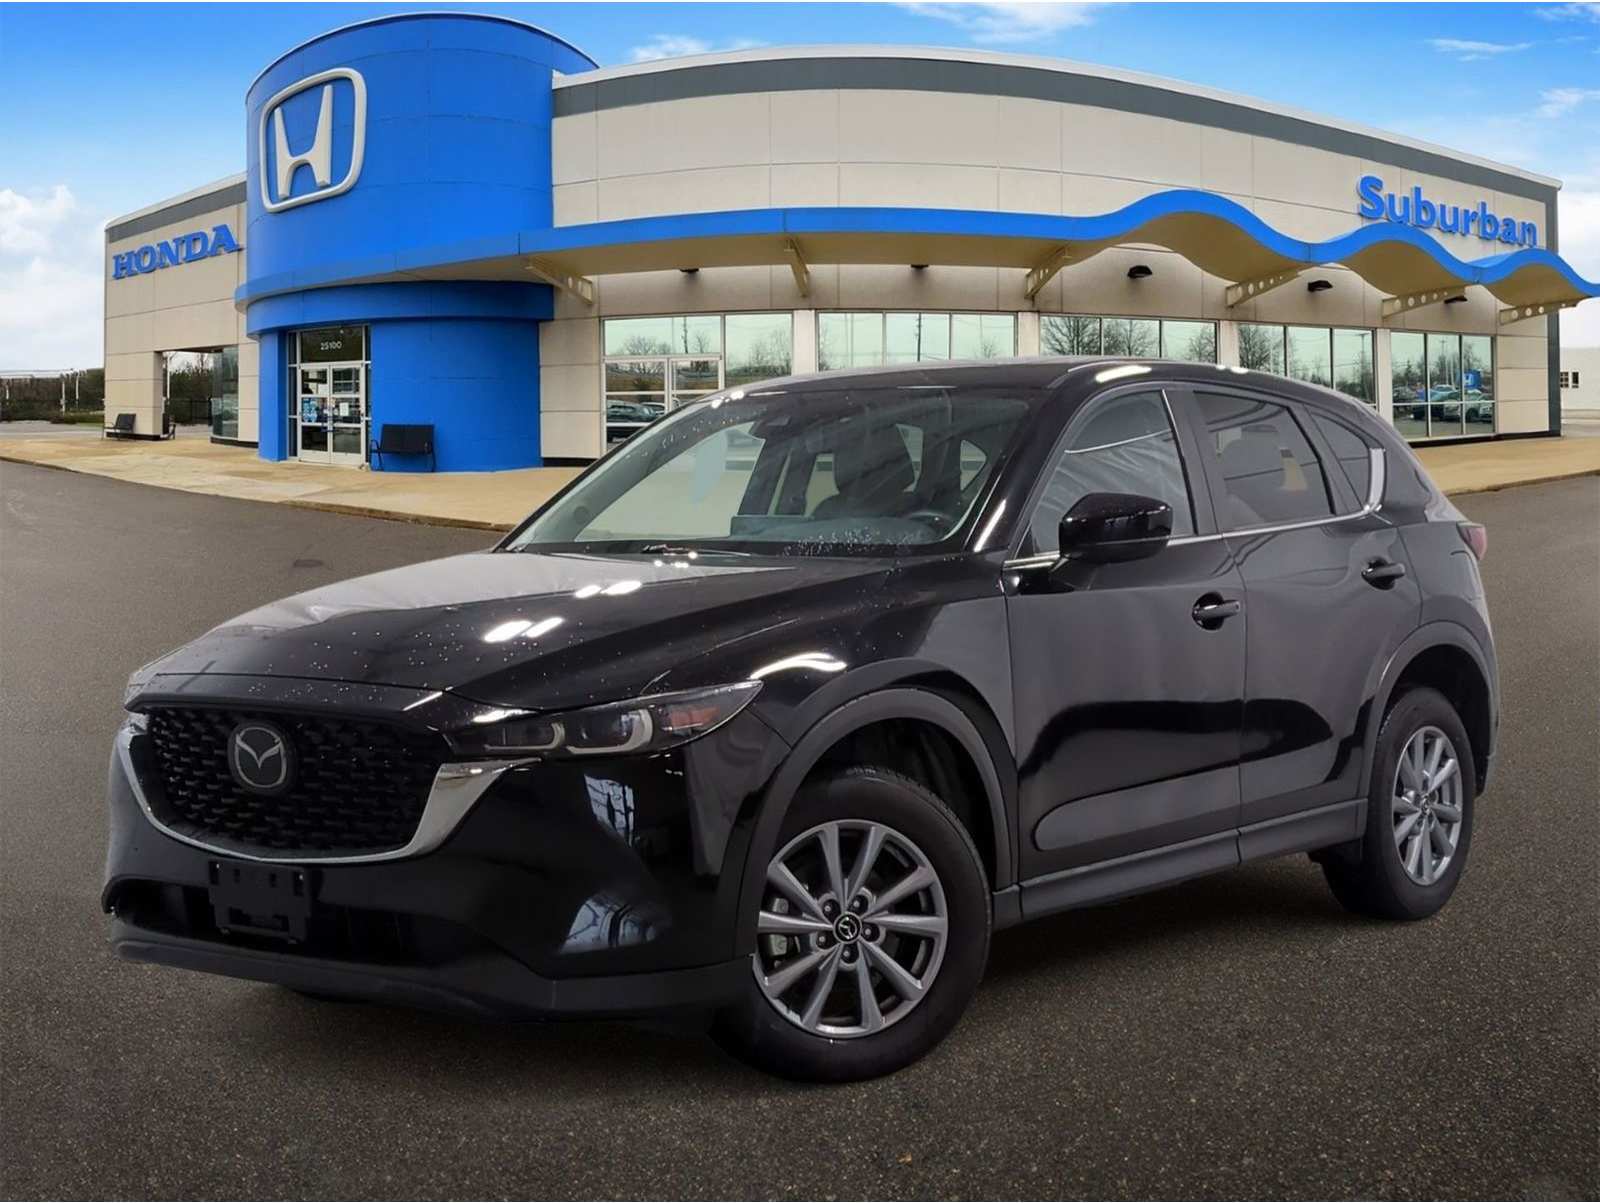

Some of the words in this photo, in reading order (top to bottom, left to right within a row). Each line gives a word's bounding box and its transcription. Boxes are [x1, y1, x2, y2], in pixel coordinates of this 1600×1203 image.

[1358, 175, 1537, 247] Suburban
[112, 223, 241, 280] HONDA
[320, 340, 342, 350] 25100
